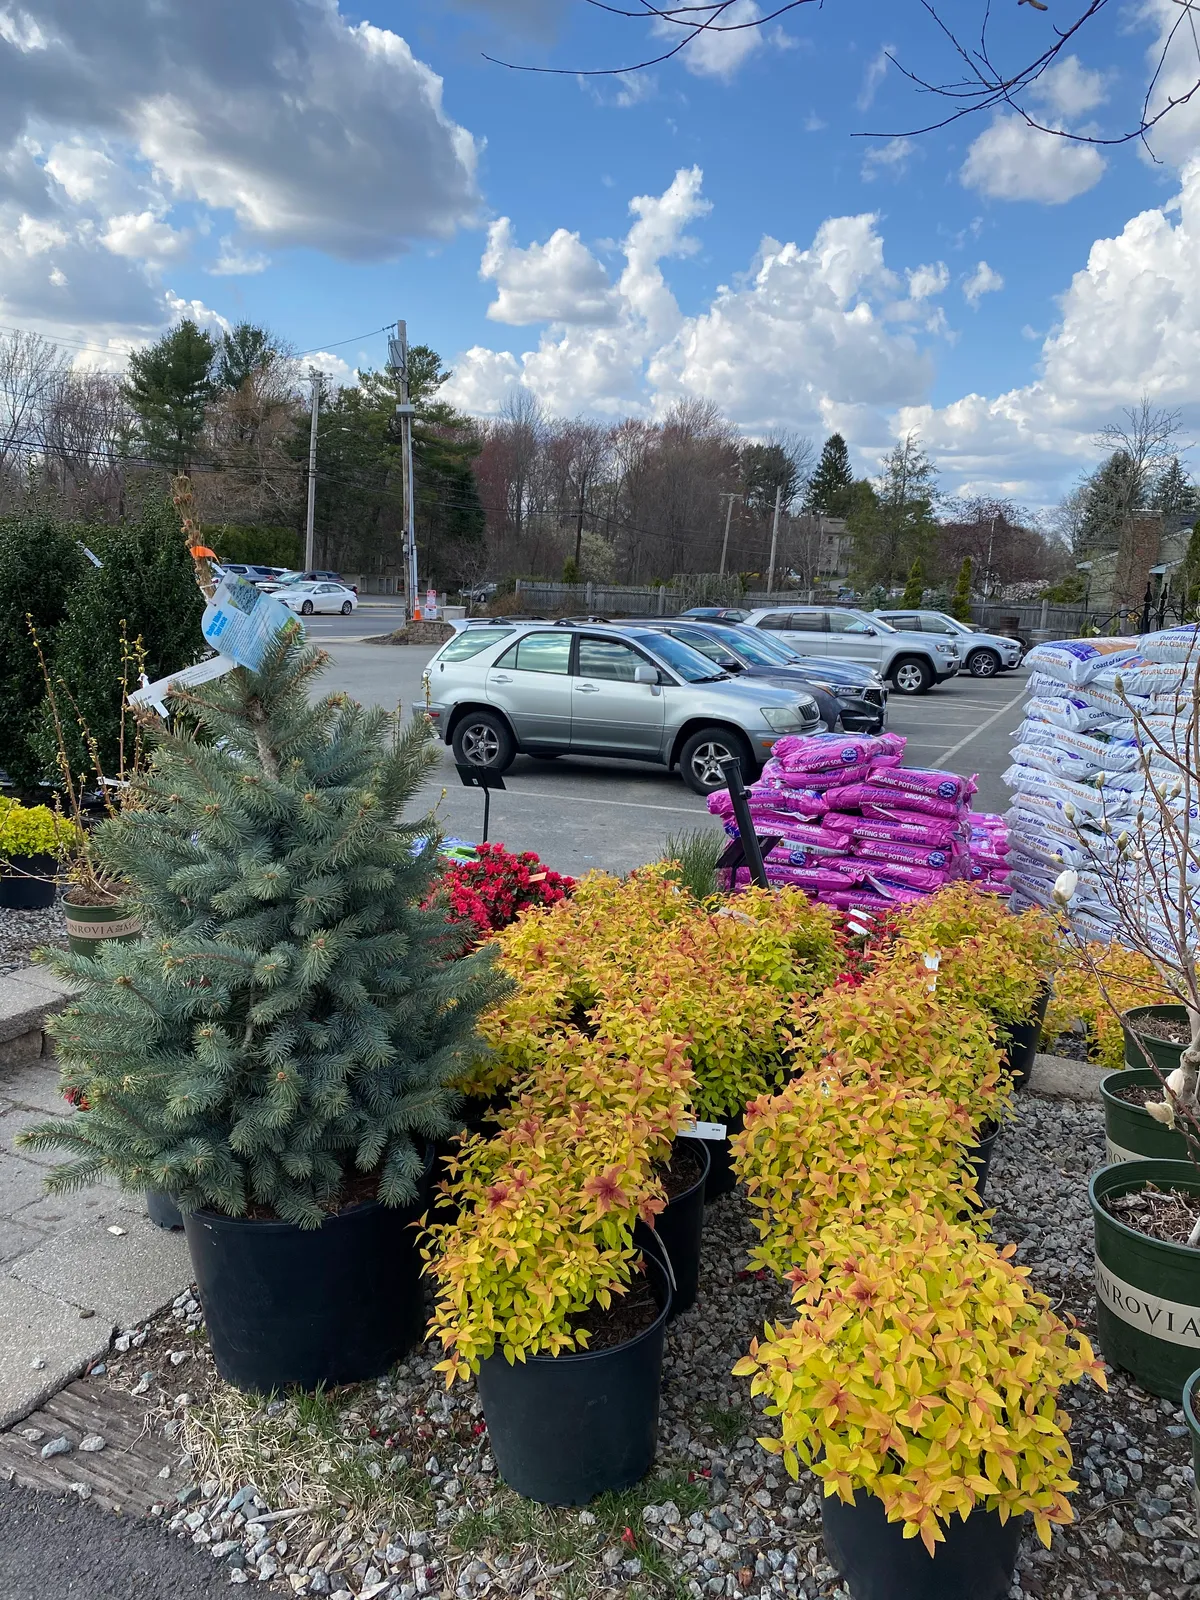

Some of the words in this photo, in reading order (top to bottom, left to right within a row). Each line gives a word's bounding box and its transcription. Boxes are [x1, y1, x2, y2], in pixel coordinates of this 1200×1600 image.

[1092, 660, 1108, 670] Coast
[872, 774, 897, 786] ORGANIC
[898, 781, 924, 792] POTTING
[925, 788, 938, 796] SOIL
[905, 792, 931, 802] ORGANIC
[796, 824, 822, 834] ORGANIC
[901, 824, 928, 832] ORGANIC
[853, 828, 878, 838] POTTING
[879, 832, 891, 840] SOIL
[862, 848, 887, 858] ORGANIC
[888, 854, 914, 863] POTTING
[793, 868, 818, 877] ORGANIC
[886, 863, 914, 874] ORGANIC
